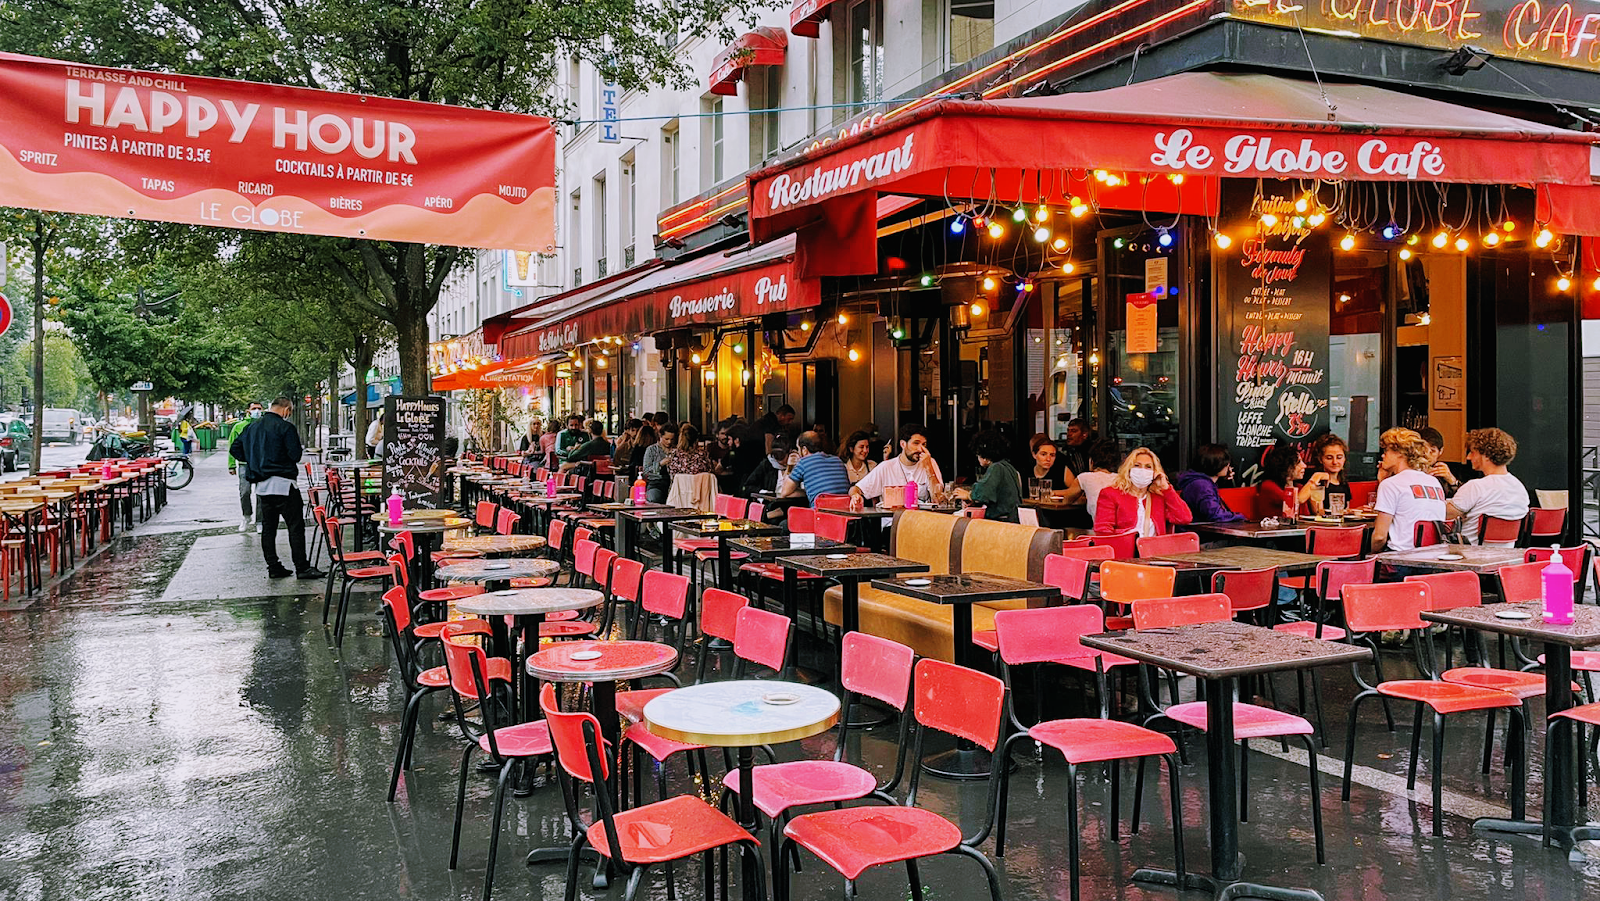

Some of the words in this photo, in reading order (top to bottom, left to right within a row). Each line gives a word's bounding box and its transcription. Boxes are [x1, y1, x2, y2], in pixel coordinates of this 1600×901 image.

[66, 66, 126, 84] TERRASSE
[128, 75, 153, 87] AND
[154, 78, 187, 92] CHILL
[65, 78, 260, 143] HAPPY
[272, 107, 418, 165] HOUR
[603, 79, 617, 140] TEL
[19, 150, 58, 166] SPRITZ
[64, 132, 107, 151] PINTES
[110, 135, 119, 153] À
[122, 139, 164, 158] PARTIR
[168, 145, 184, 160] DE
[1150, 128, 1214, 170] Le
[1223, 132, 1348, 175] Globe
[1357, 139, 1446, 180] Café
[275, 159, 335, 178] COCKTAILS
[336, 162, 344, 179] À
[346, 166, 383, 184] PARTIR
[385, 172, 399, 185] DE
[400, 173, 413, 187] 5€
[768, 132, 915, 210] Restaurant
[141, 178, 175, 192] TAPAS
[238, 181, 274, 196] RICARD
[498, 184, 527, 198] MOJITO
[200, 202, 221, 221] LE
[231, 205, 304, 228] GLOBE
[330, 196, 363, 211] BIÈRES
[424, 196, 453, 209] APÉRO
[669, 287, 735, 318] Brasserie
[754, 275, 788, 305] Pub
[1292, 350, 1314, 367] 16H
[1238, 411, 1264, 424] LEFFE
[1275, 392, 1317, 425] Stella
[1236, 423, 1274, 437] BLANCHE
